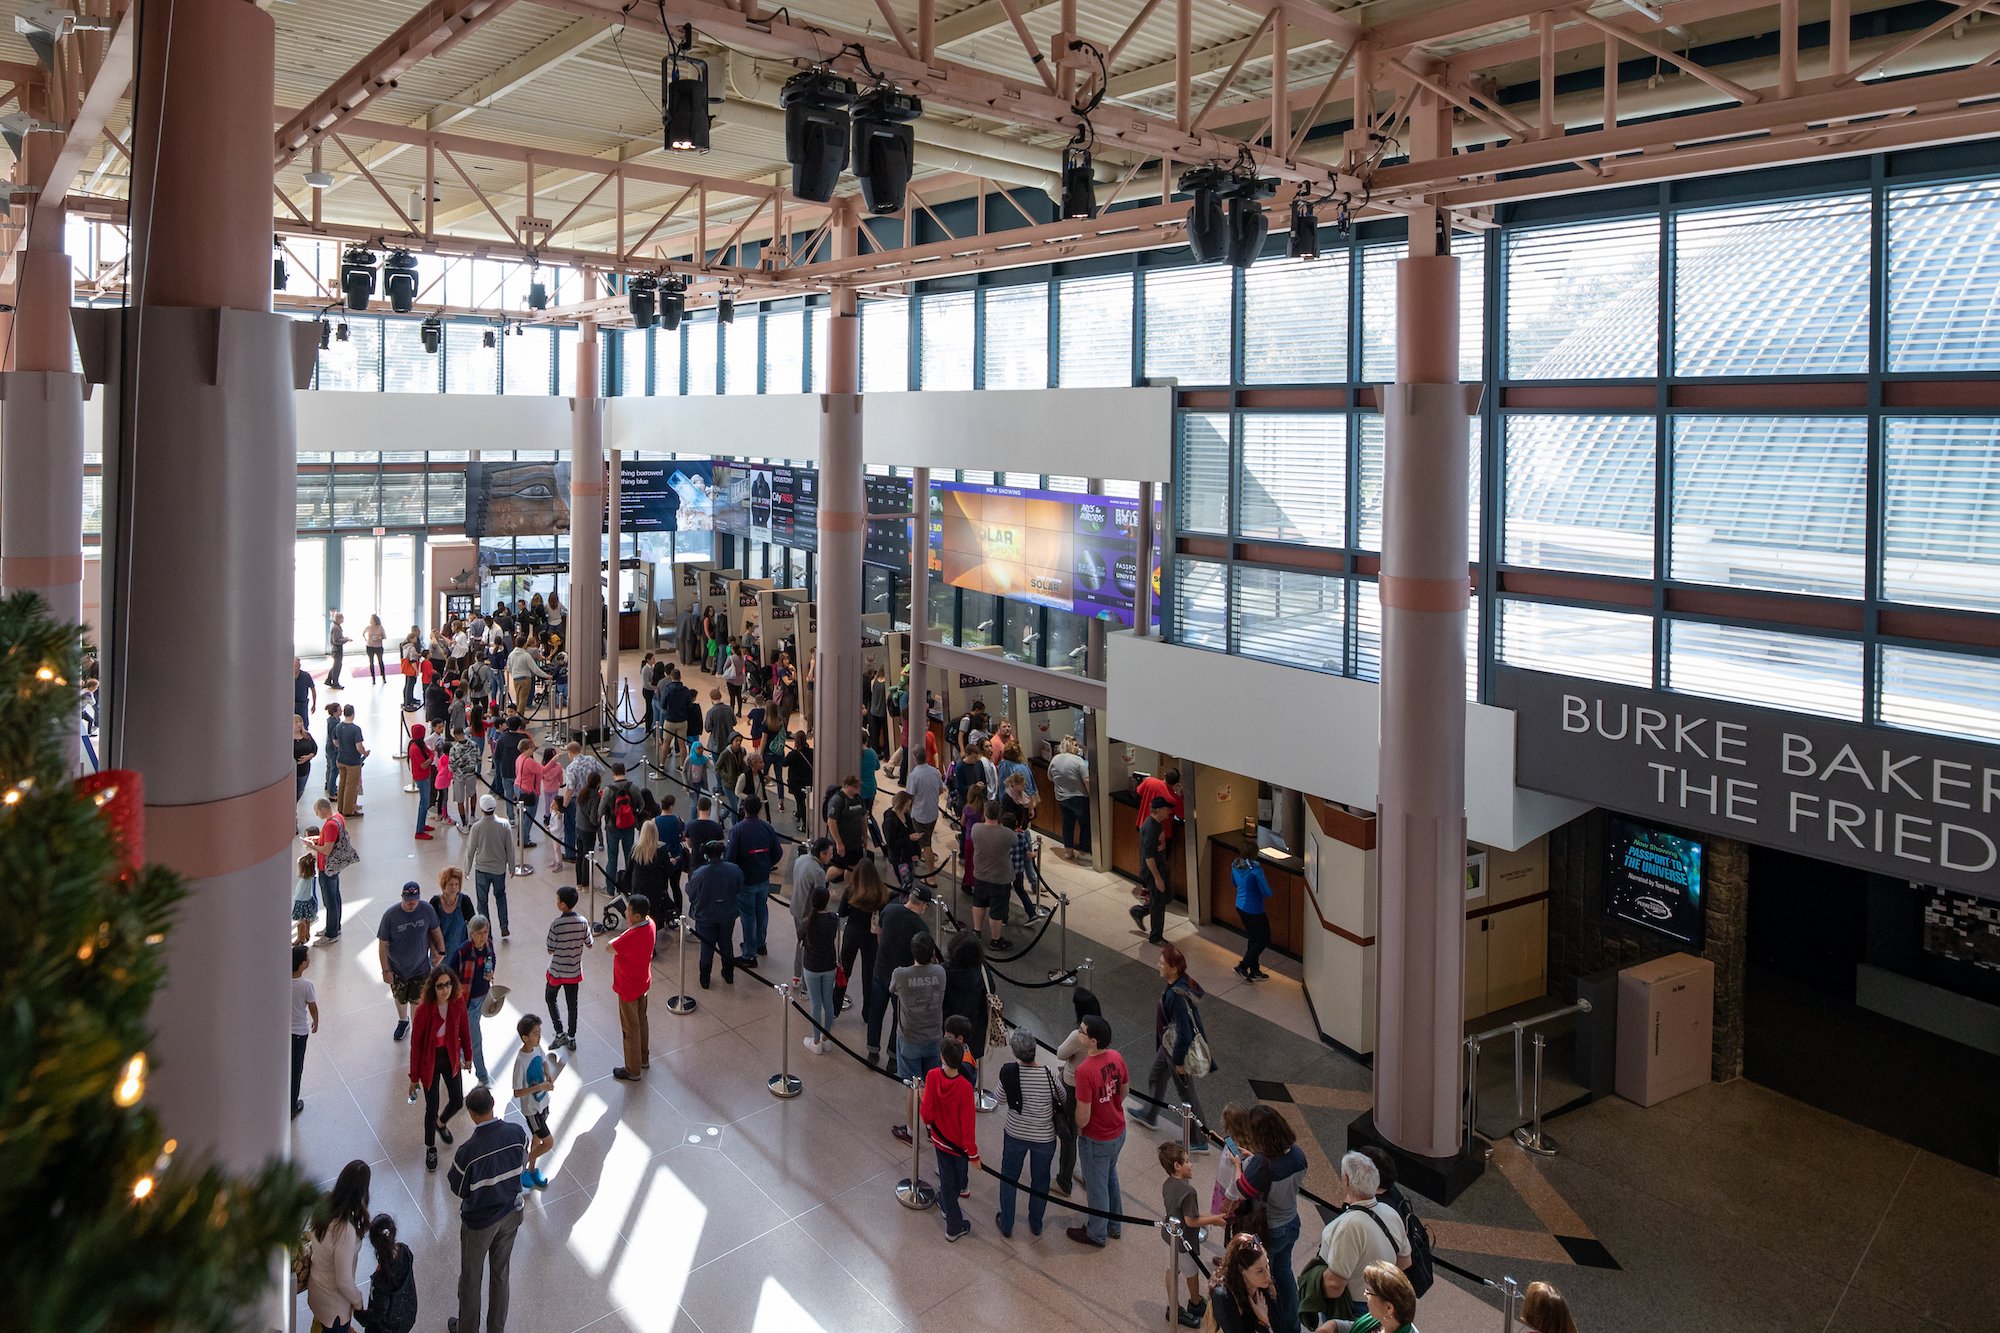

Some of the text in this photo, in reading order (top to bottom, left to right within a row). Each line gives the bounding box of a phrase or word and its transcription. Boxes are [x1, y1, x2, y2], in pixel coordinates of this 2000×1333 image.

[1031, 578, 1059, 592] SOLAR
[1562, 694, 1749, 767] BURKE
[1648, 761, 1998, 874] THE FRIED
[1628, 846, 1683, 871] PASSPORT TO
[1633, 839, 1678, 860] Now Showing
[1624, 855, 1688, 886] THE UNIVERSE
[1627, 872, 1680, 895] Narrated by Tom Hanks
[909, 975, 940, 987] NASA
